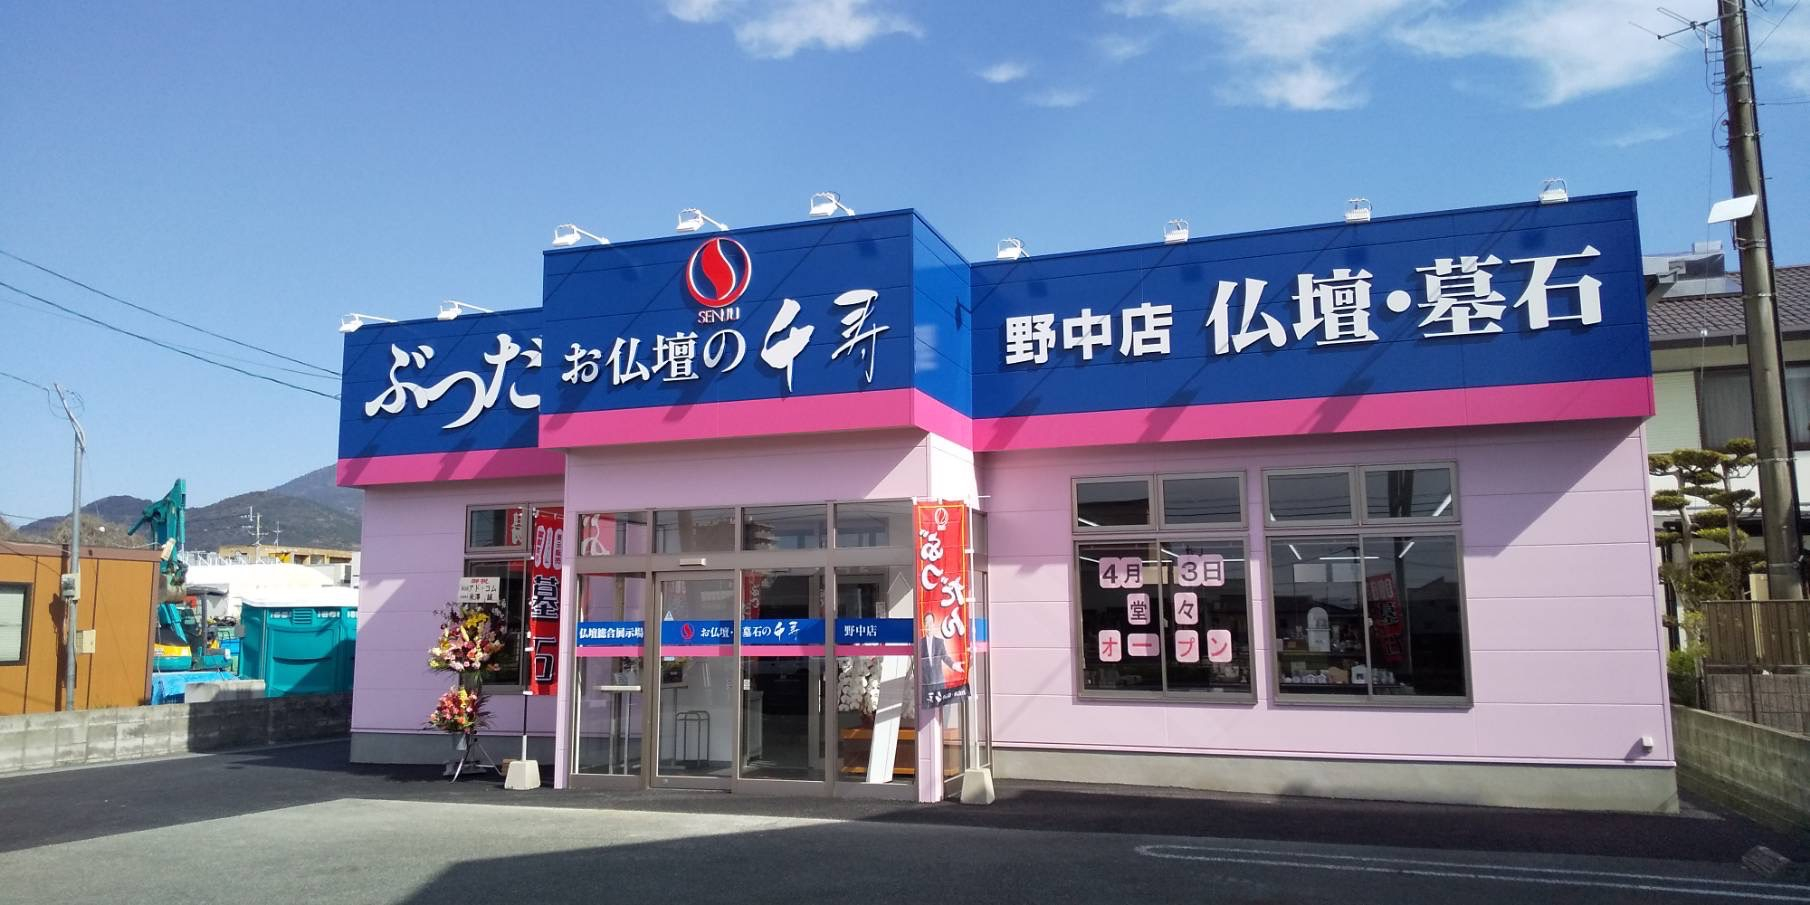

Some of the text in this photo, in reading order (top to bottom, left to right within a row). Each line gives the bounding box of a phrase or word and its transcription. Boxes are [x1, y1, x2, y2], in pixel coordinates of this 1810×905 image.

[697, 306, 740, 324] SENJU
[1005, 245, 1603, 366] 野中店 仏壇・墓石
[843, 624, 878, 637] 野中店
[1102, 637, 1228, 658] オープン
